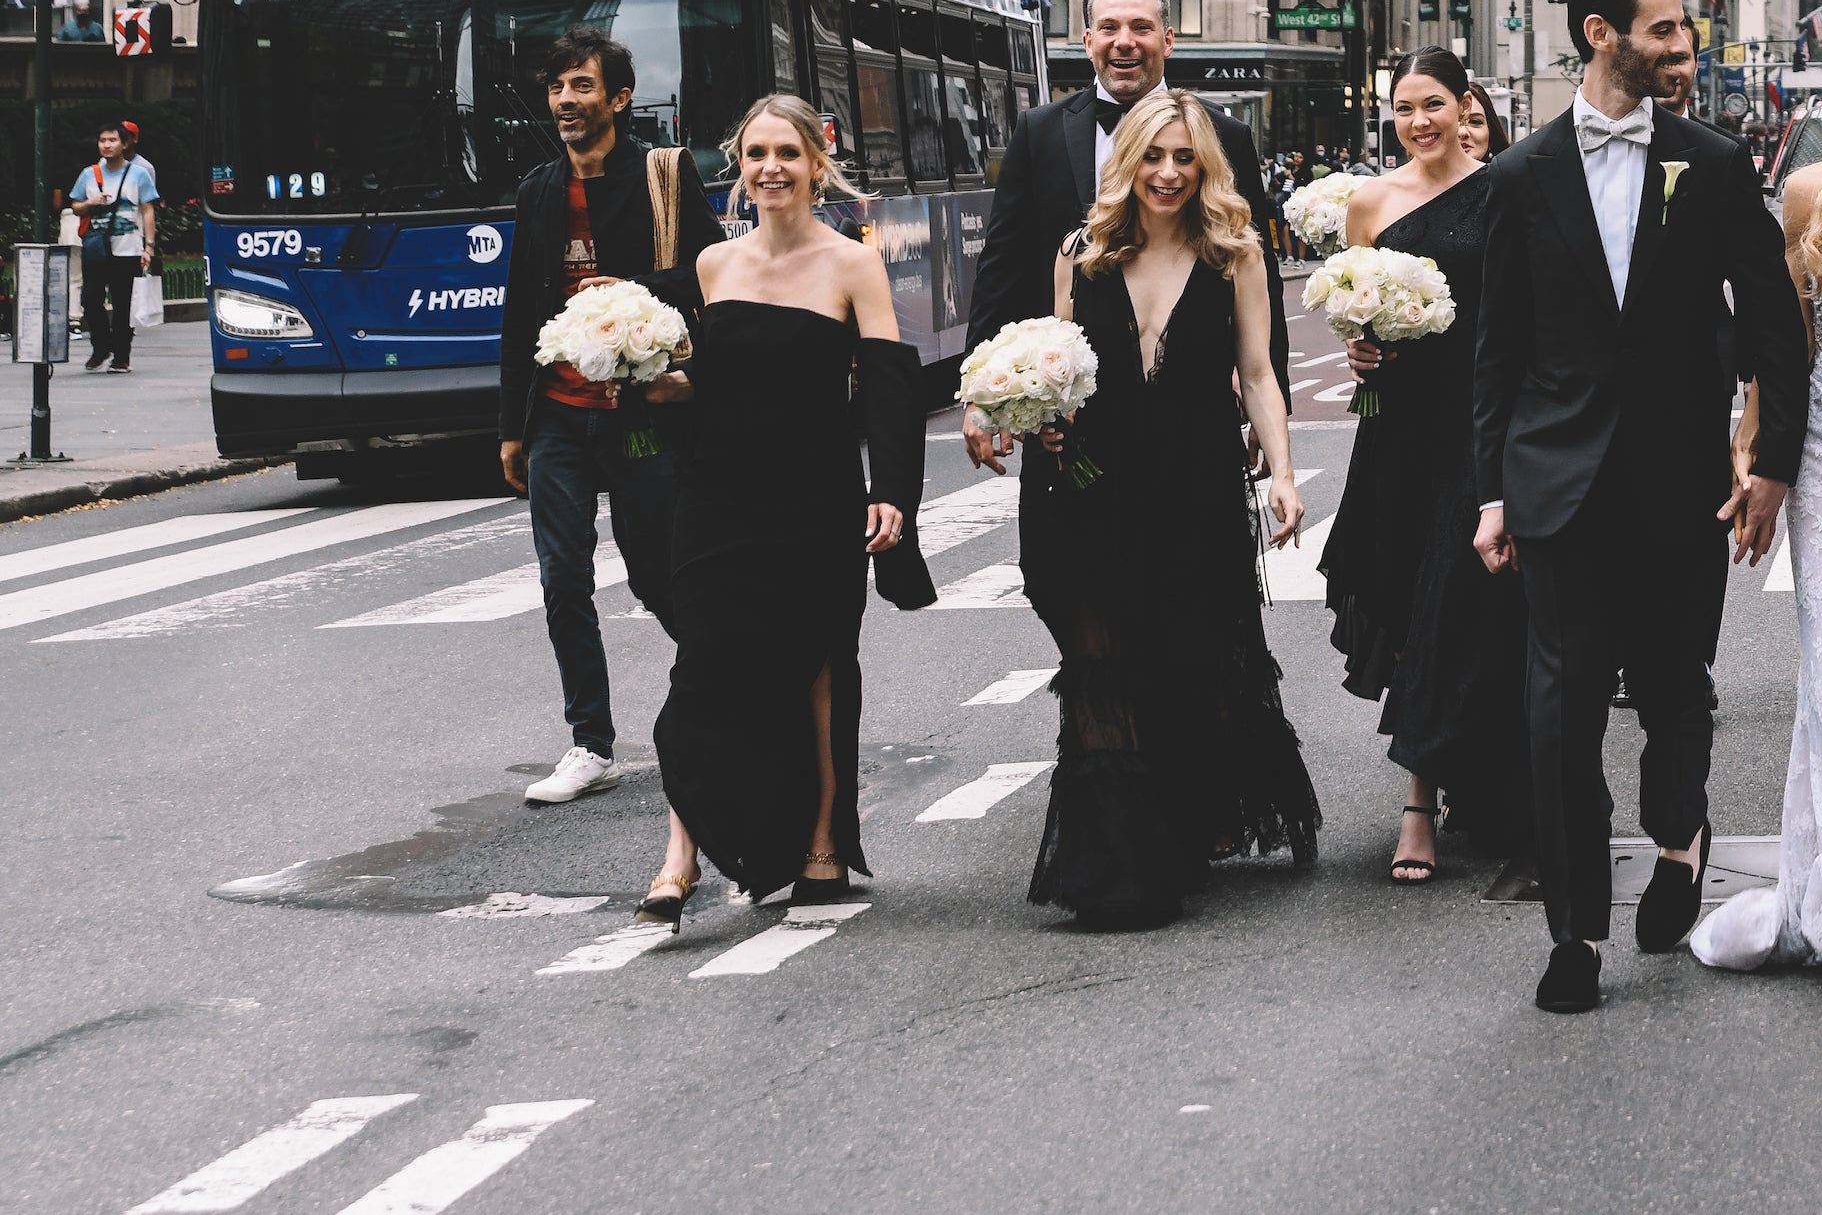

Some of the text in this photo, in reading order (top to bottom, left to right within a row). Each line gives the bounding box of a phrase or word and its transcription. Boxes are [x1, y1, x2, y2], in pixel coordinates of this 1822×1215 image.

[1278, 14, 1305, 25] West
[1307, 14, 1328, 25] 42nd
[1205, 68, 1261, 79] ZARA
[237, 229, 302, 258] 9579
[468, 236, 496, 256] MTA
[427, 286, 506, 311] HYBRI
